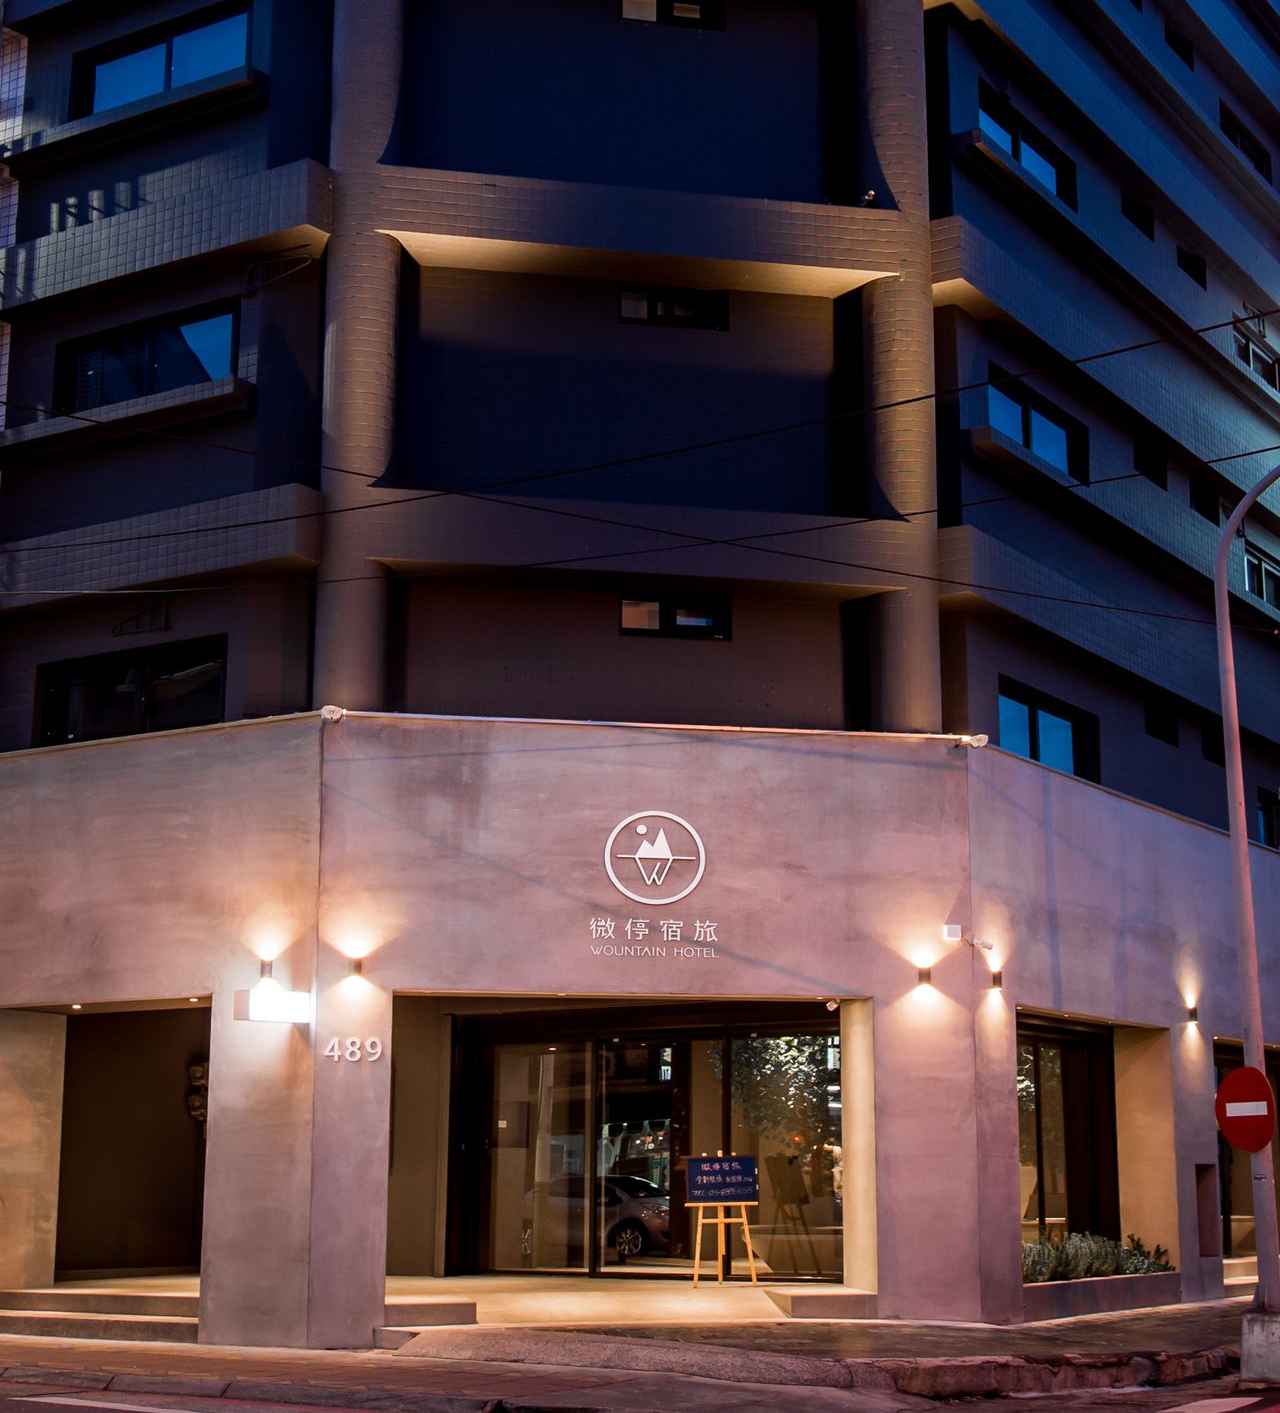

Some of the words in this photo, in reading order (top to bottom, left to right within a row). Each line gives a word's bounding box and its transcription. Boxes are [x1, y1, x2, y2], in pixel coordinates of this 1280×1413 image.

[589, 917, 718, 942] 微停宿旅
[590, 945, 666, 957] WOUNTAIN
[673, 947, 720, 958] HOTEL
[323, 1036, 382, 1062] 489
